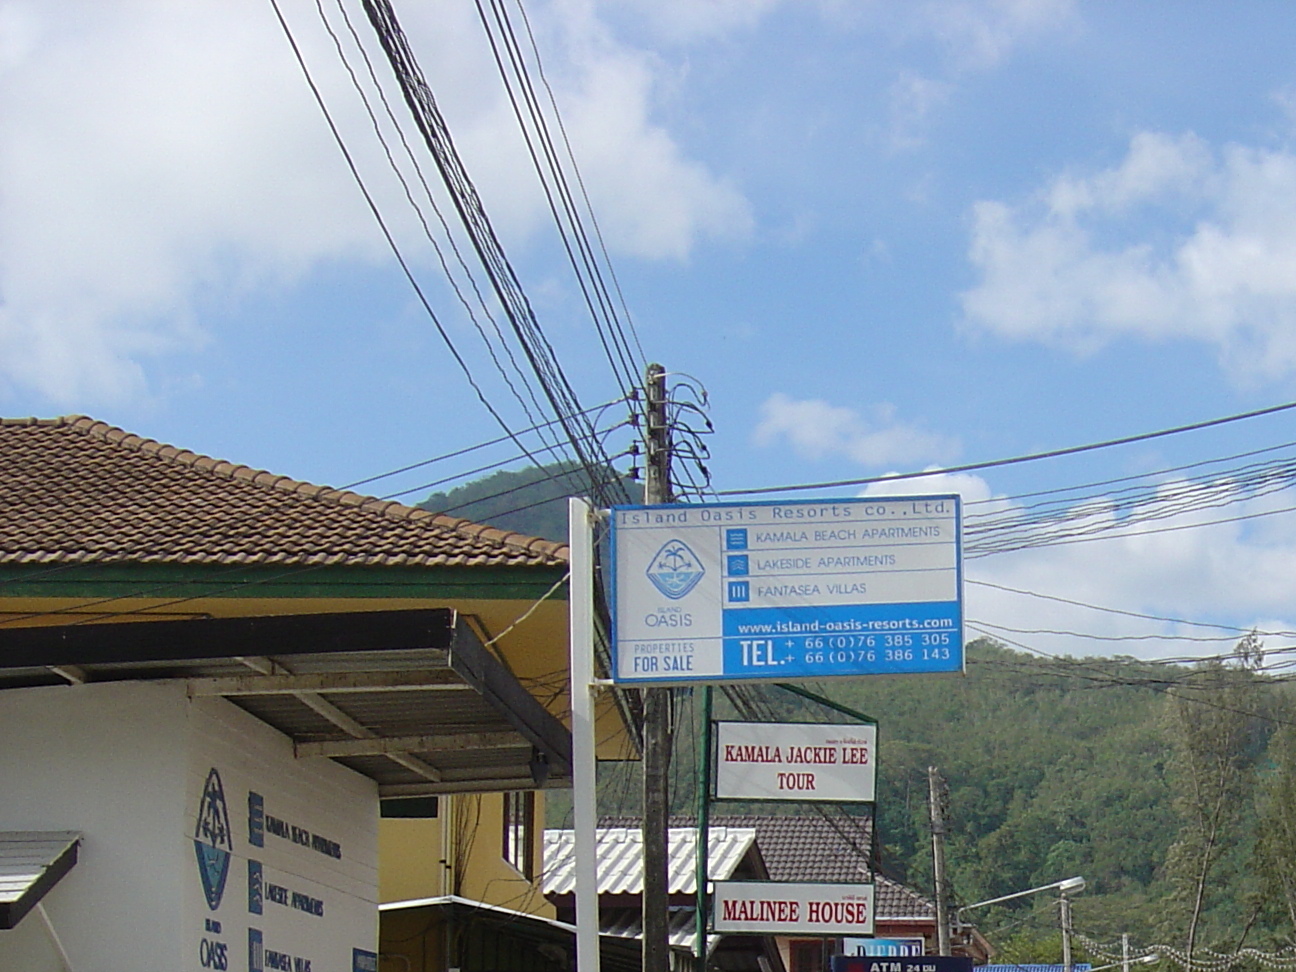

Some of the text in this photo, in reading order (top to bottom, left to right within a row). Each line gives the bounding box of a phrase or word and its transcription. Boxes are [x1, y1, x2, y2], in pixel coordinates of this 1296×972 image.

[622, 511, 687, 525] Island
[701, 507, 757, 521] Oasis
[773, 504, 851, 519] Resorts
[756, 526, 940, 543] KAMALA BEACH APARTMENTS
[757, 555, 896, 570] LAKESIDE APARTMENTS
[758, 583, 866, 597] FANTASEA VILLAS
[645, 614, 692, 627] OASIS
[738, 618, 953, 634] www.island-oasis-resorts.com
[634, 643, 694, 654] PROPERTIES
[805, 635, 876, 650] 66(0)76
[885, 635, 913, 647] 385
[922, 633, 949, 645] 305
[740, 640, 785, 666] TEL.
[805, 651, 876, 664] 66(0)76
[885, 649, 913, 661] 386
[922, 648, 950, 660] 143
[634, 655, 694, 672] FOR SALE
[725, 745, 868, 765] KAMALA JACKIE LEE
[777, 773, 815, 790] TOUR
[723, 900, 866, 924] MALINEE HOUSE
[870, 962, 901, 972] ATM
[906, 964, 920, 972] 24
